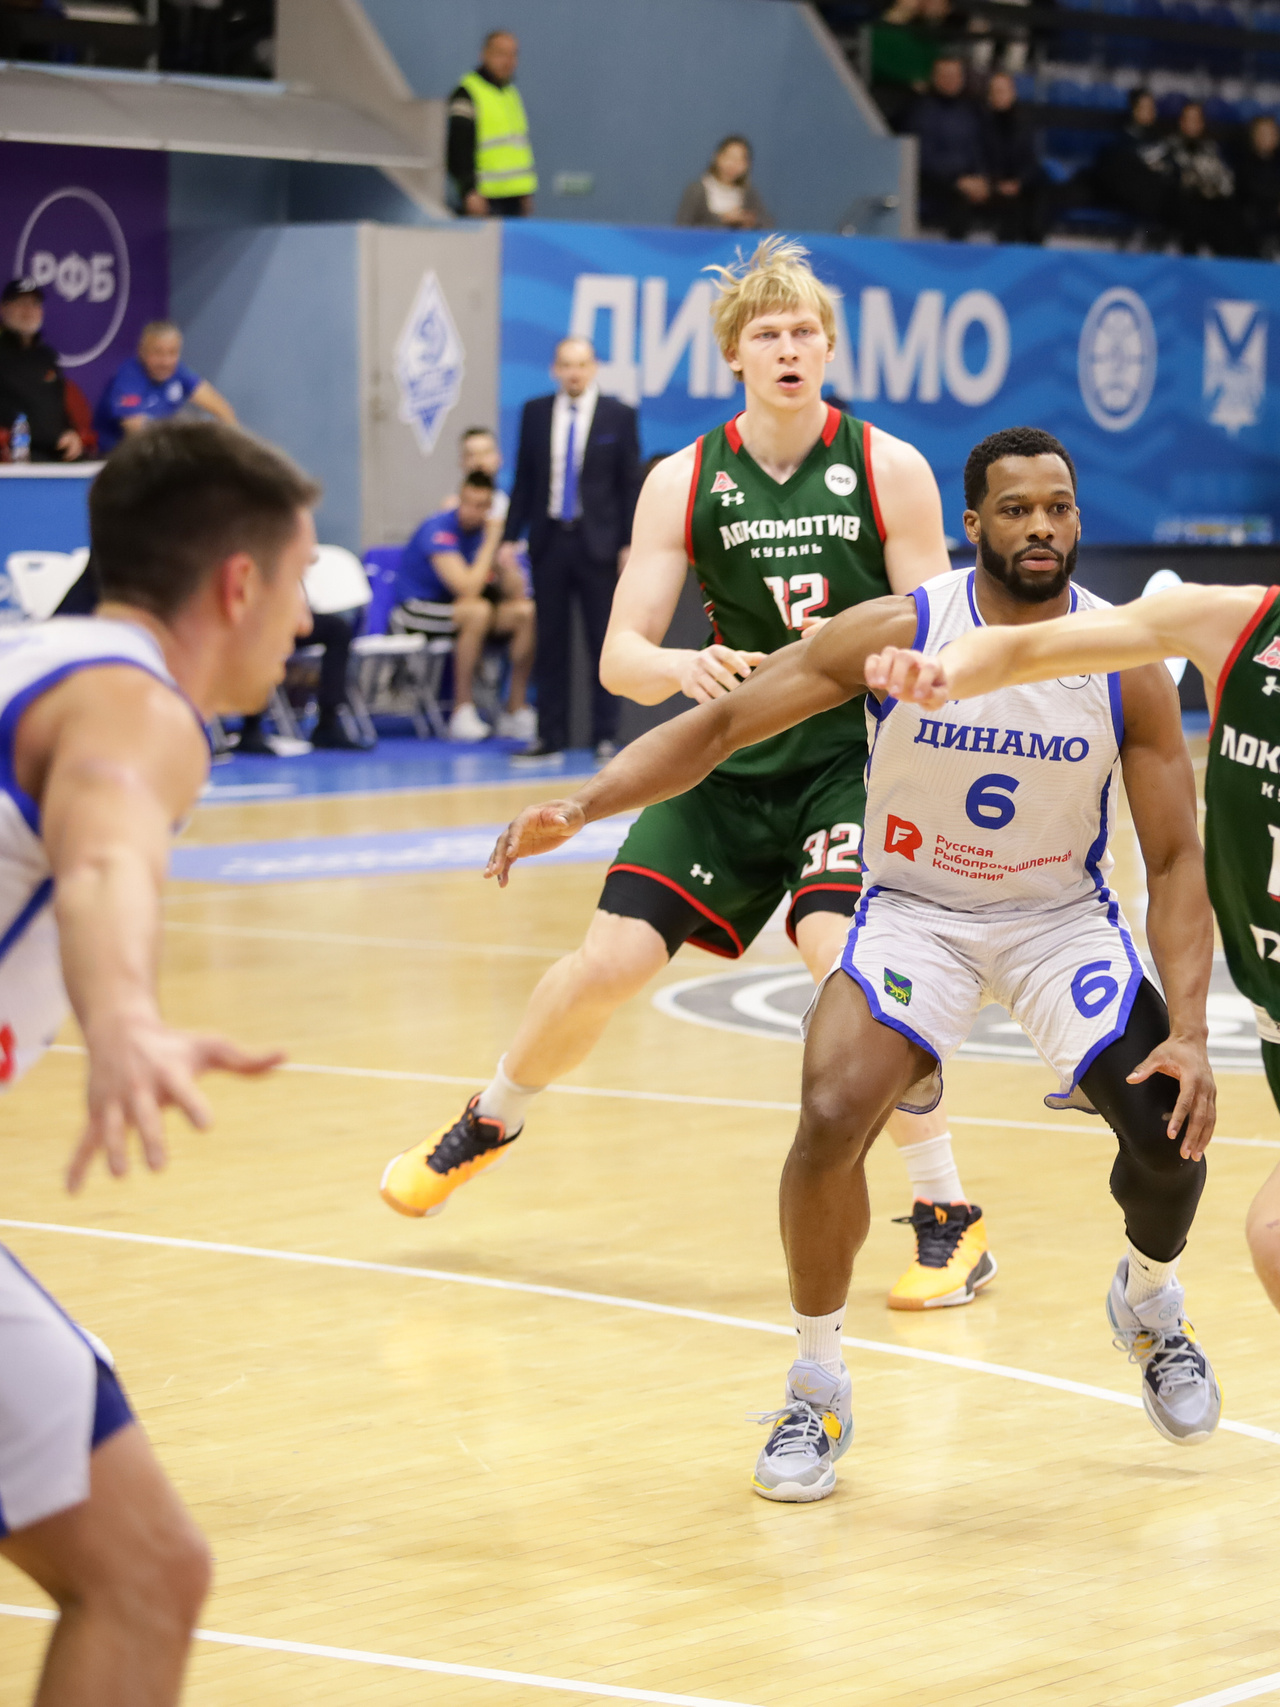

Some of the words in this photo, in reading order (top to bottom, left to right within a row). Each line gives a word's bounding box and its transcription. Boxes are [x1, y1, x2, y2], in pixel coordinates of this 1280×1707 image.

[31, 251, 116, 302] РФБ
[718, 514, 861, 550] ЛОКОМОТИВ
[750, 543, 823, 559] КУБАНЬ
[914, 718, 1090, 763] ДИНАМО
[965, 773, 1021, 831] 6
[800, 822, 862, 880] 32
[934, 846, 1074, 874] Рыбопромышленная
[936, 833, 994, 859] Русская
[932, 857, 1005, 882] Компания
[1070, 960, 1119, 1019] 6
